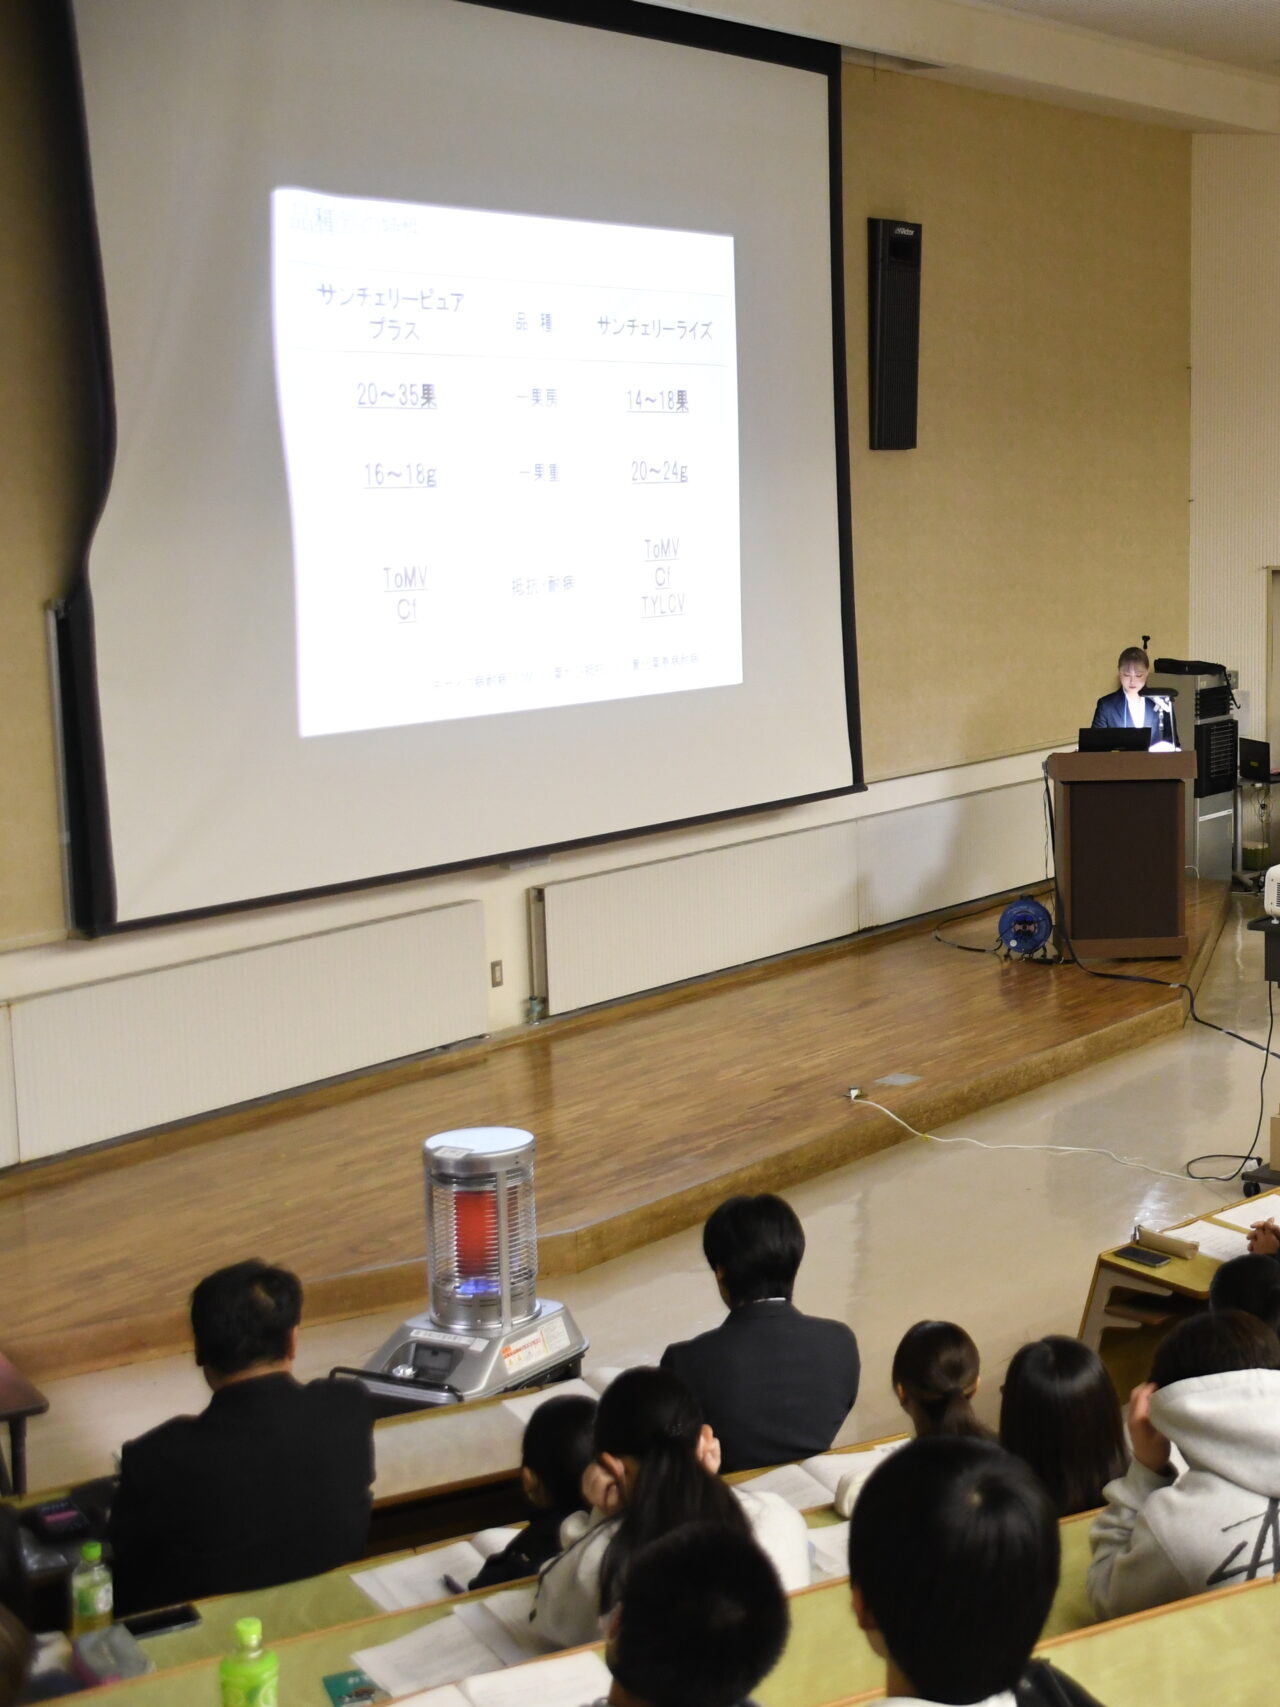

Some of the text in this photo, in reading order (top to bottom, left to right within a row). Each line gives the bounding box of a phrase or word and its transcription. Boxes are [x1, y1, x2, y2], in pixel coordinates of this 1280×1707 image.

[316, 283, 465, 312] サンチェリーピュア
[369, 317, 420, 341] プラス
[597, 315, 713, 340] サンチェリーライズ
[644, 538, 680, 561] ToMV
[383, 565, 428, 591] ToMV
[641, 593, 686, 618] TYLCV
